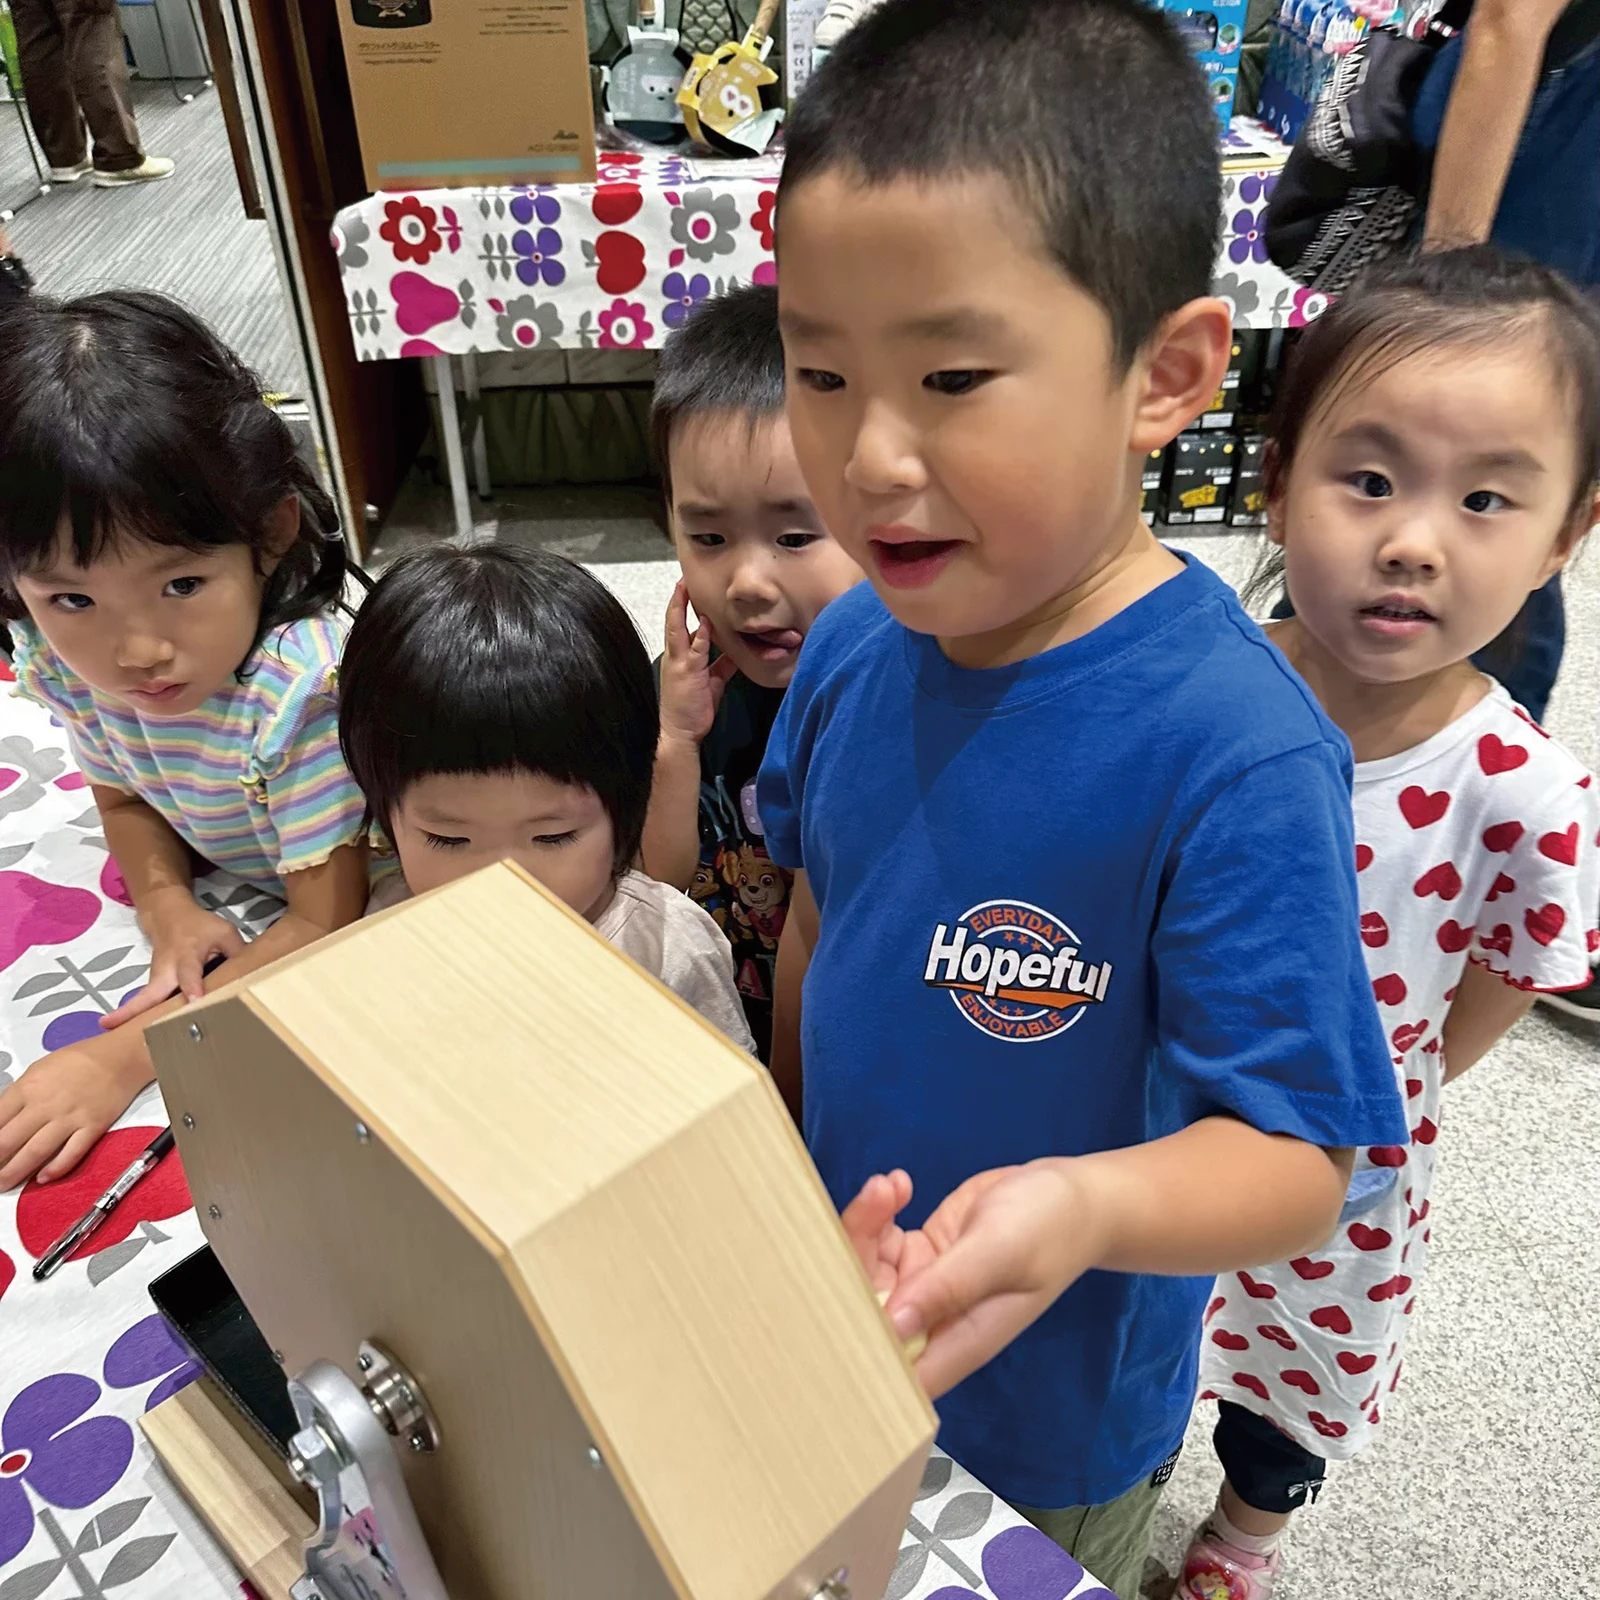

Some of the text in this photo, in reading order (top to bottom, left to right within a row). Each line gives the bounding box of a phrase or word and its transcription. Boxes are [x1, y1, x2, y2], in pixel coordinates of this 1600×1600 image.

[969, 908, 1068, 944] EVERYDAY
[924, 923, 1114, 1003] Hopeful
[960, 993, 1066, 1037] ENJOYABLE
